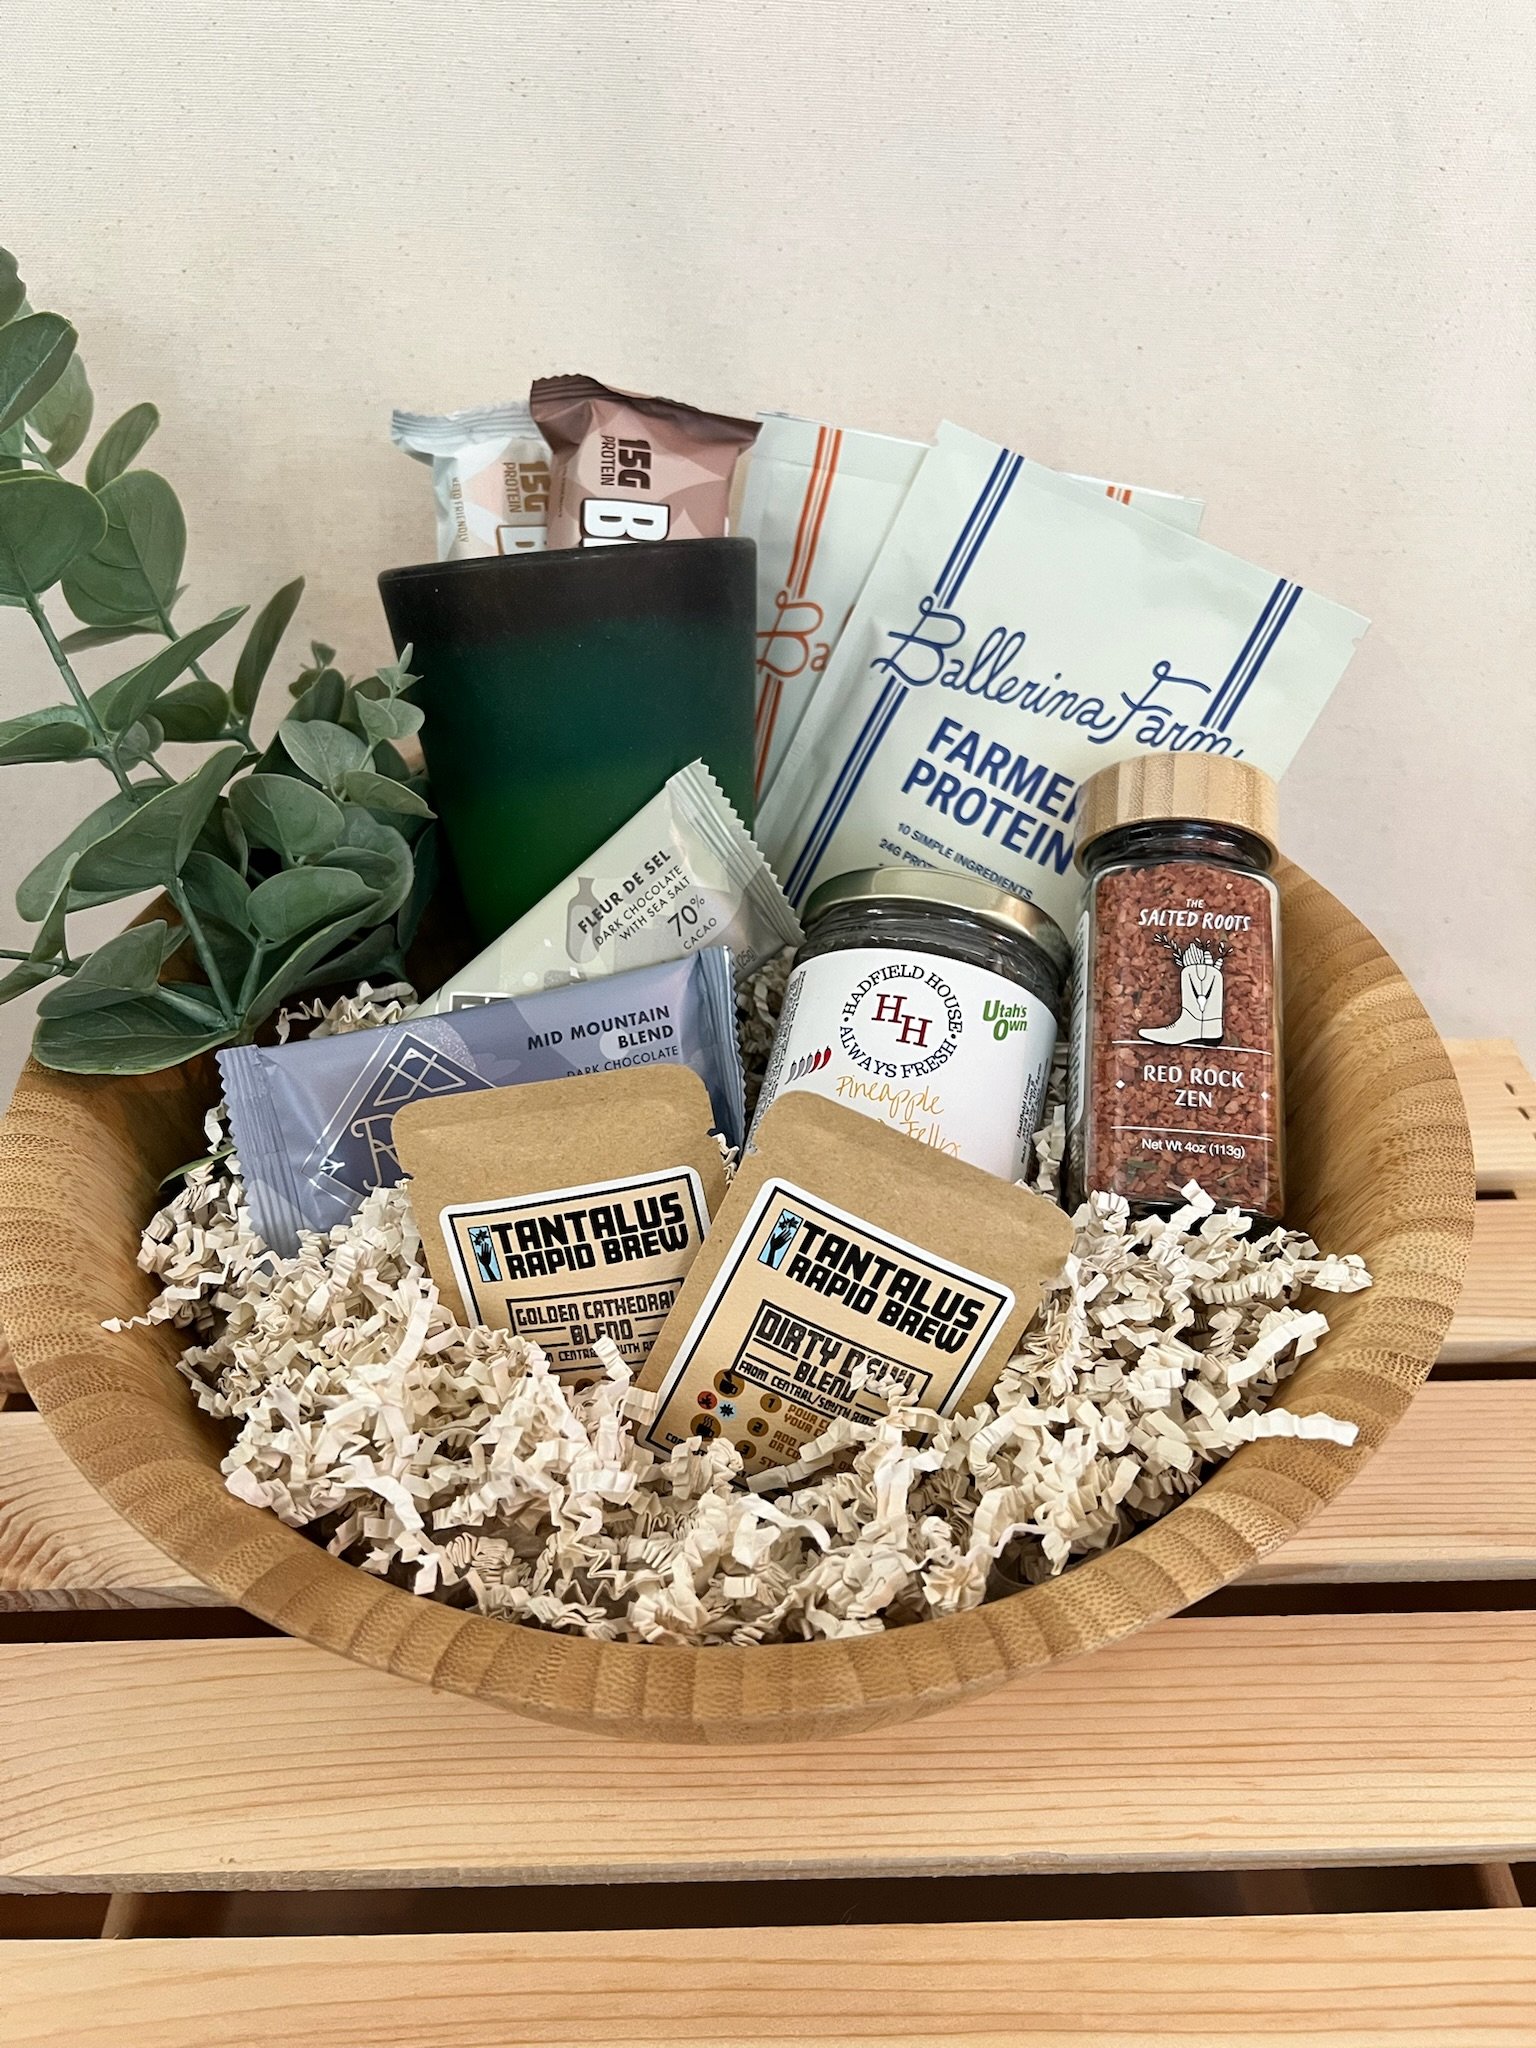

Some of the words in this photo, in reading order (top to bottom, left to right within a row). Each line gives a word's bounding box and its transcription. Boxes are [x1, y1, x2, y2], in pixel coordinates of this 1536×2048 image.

[600, 435, 616, 486] PROTEIN
[617, 438, 652, 490] 15G
[502, 462, 522, 513] PROTEIN
[454, 501, 469, 543] FRIENDLY
[869, 596, 1116, 731] Ballerina
[1087, 660, 1244, 758] Farm
[901, 758, 1075, 876] PROTEIN
[878, 838, 902, 857] 24G
[898, 823, 911, 836] 10
[911, 830, 953, 859] SIMPLE
[953, 852, 1034, 900] INGREDIENTS
[577, 892, 624, 934] FLEUR
[622, 872, 645, 895] DE
[643, 850, 672, 876] SEL
[594, 919, 624, 946] DARK
[623, 865, 683, 919] CHOCOLATE
[619, 916, 648, 941] WITH
[648, 899, 668, 918] SEA
[669, 875, 692, 900] SALT
[1186, 898, 1204, 909] THE
[667, 894, 705, 938] 70%
[683, 917, 718, 950] CACAO
[1138, 908, 1198, 927] SALTED
[1201, 914, 1251, 932] ROOTS
[841, 964, 925, 1016] HADFIELD
[924, 972, 963, 1034] HOUSE
[982, 1000, 1028, 1022] Utah's
[527, 1029, 563, 1051] MID
[571, 1005, 670, 1040] MOUNTAIN
[618, 1025, 674, 1049] BLEND
[993, 1019, 1028, 1041] Own
[604, 1045, 679, 1071] CHOCOLATE
[839, 1025, 897, 1079] ALWAYS
[900, 1038, 957, 1079] FRESH
[1143, 1064, 1183, 1083] RED
[1189, 1068, 1245, 1089] ROCK
[836, 1075, 944, 1122] Pineapple
[1174, 1089, 1212, 1108] ZEN
[1141, 1138, 1163, 1150] Net
[1165, 1140, 1183, 1152] Wt
[1184, 1143, 1207, 1154] 4oz
[1209, 1144, 1246, 1159] (113g)
[490, 1192, 685, 1254] TANTALUS
[505, 1243, 596, 1280] RAPID
[601, 1223, 690, 1265] BREW
[799, 1219, 985, 1331] TANTALUS
[515, 1303, 580, 1326] GOLDEN
[785, 1253, 879, 1316] RAPID
[877, 1300, 969, 1354] BREW
[570, 1319, 633, 1346] BLEND
[755, 1308, 843, 1368] DIRTY
[738, 1360, 767, 1383] FROM
[794, 1361, 859, 1404] BLEND
[768, 1397, 776, 1409] 1
[787, 1404, 817, 1425] POUR
[784, 1413, 813, 1433] YOUR
[742, 1444, 751, 1456] 3
[752, 1421, 763, 1433] 2
[773, 1430, 797, 1446] ADD
[769, 1440, 783, 1453] OR
